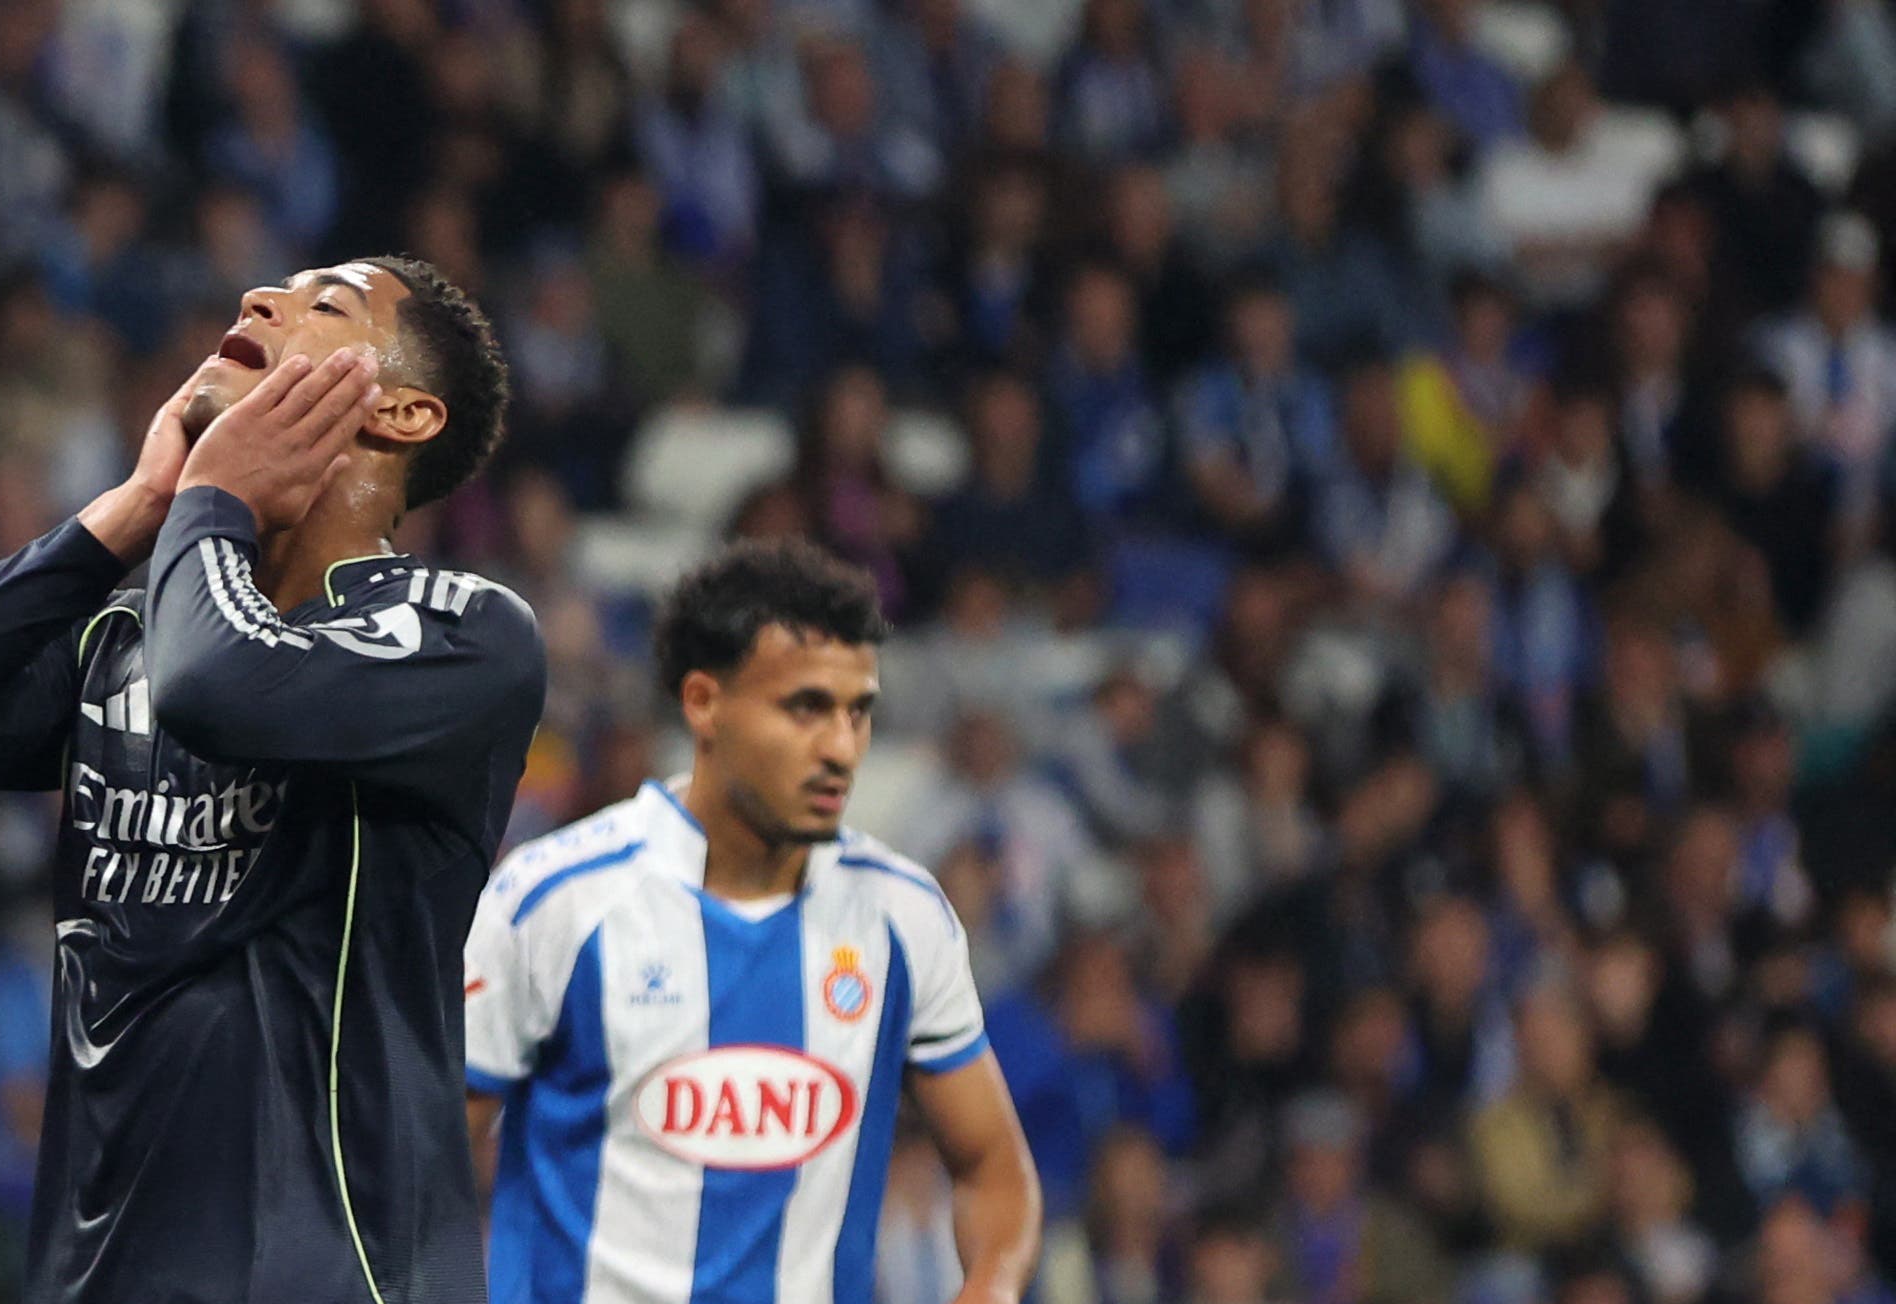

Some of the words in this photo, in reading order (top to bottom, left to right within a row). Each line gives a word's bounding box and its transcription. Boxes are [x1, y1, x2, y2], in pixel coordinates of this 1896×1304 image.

[70, 761, 288, 850] Emirate
[82, 846, 140, 903] FLY
[141, 849, 261, 904] BETTE
[662, 1075, 823, 1136] DANI
